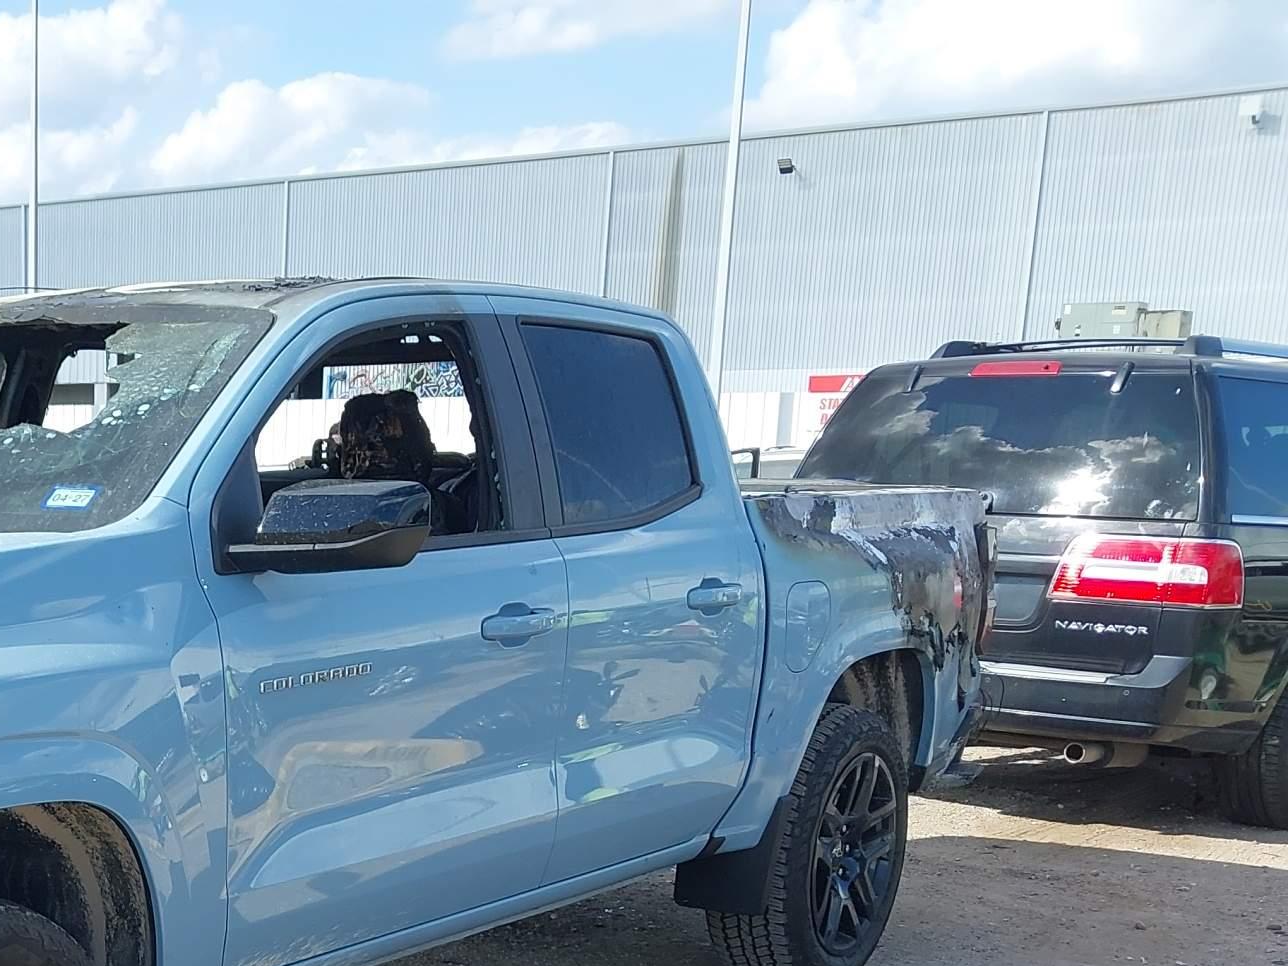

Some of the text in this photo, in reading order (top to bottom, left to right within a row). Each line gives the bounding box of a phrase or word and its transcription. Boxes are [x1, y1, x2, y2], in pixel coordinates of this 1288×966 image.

[819, 398, 844, 410] STA
[1055, 620, 1149, 635] NAVIGATOR
[259, 661, 373, 694] COLORADO
